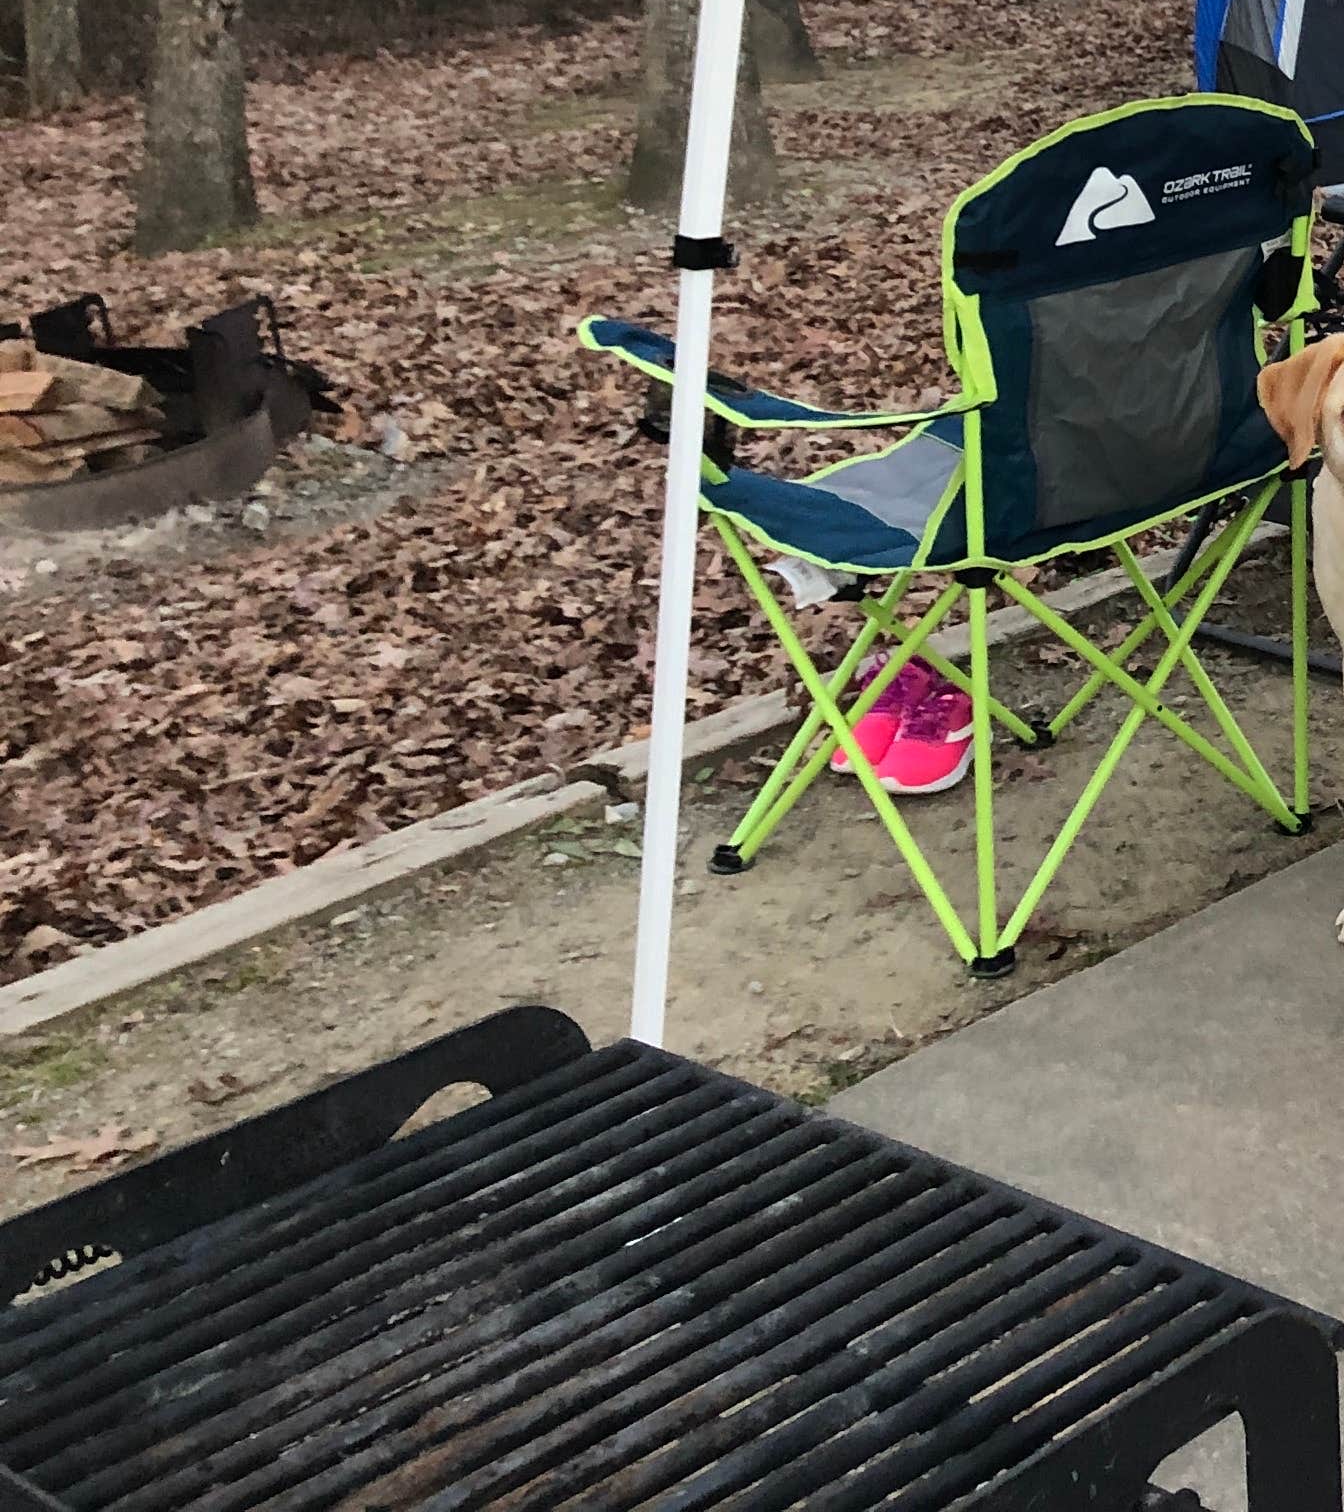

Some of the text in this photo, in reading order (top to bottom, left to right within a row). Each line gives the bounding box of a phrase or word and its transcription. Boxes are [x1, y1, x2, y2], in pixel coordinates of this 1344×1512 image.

[1161, 178, 1250, 204] OUTDOOR EQUIPMENT
[1162, 172, 1211, 194] OZARK
